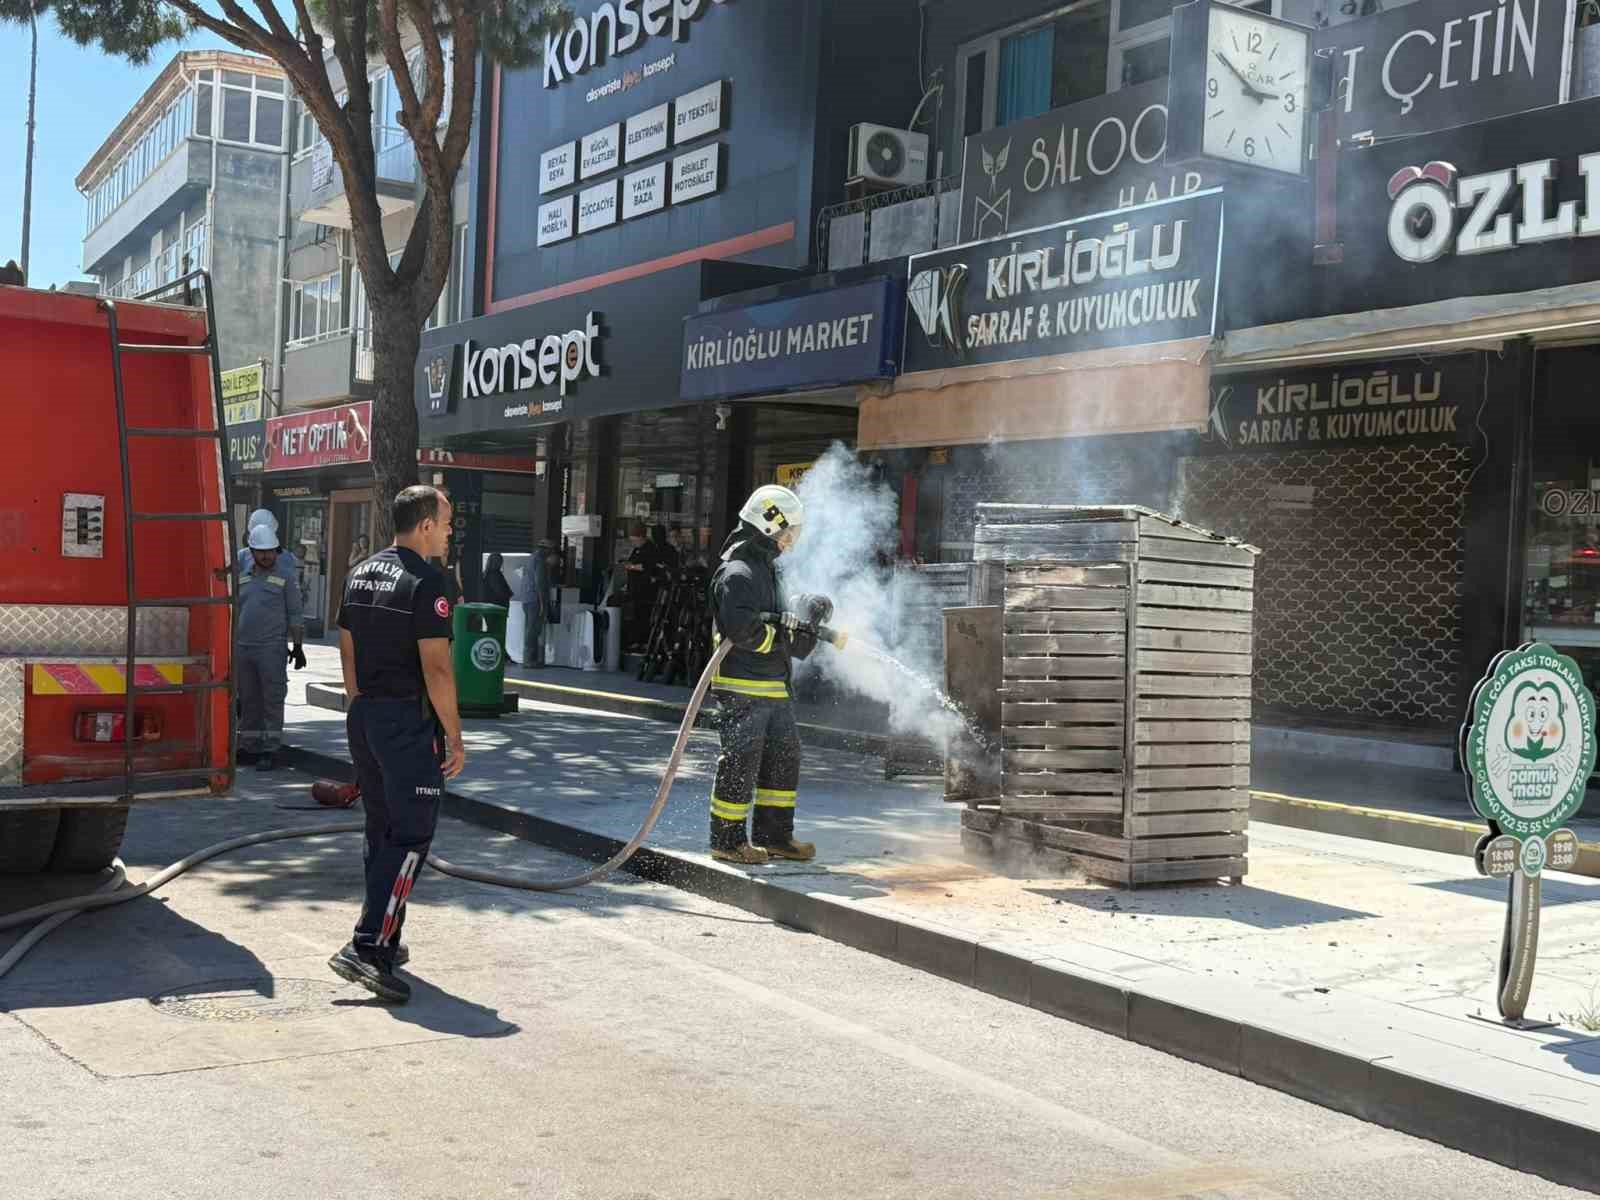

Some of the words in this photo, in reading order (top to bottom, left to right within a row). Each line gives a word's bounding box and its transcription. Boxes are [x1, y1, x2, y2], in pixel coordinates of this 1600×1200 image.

[1247, 32, 1263, 54] 12
[1207, 78, 1218, 98] 9
[1284, 93, 1296, 113] 3
[677, 112, 687, 126] EV
[1243, 137, 1255, 158] 6
[547, 153, 567, 169] BEYAZ
[632, 176, 656, 192] YATAK
[633, 192, 653, 206] BAZA
[986, 220, 1190, 301] KİRLİOĞLU
[966, 307, 1034, 349] SARRAF
[1037, 309, 1051, 339] &
[1056, 279, 1201, 337] KUYUMCULUK
[462, 311, 600, 398] konsept
[686, 325, 782, 371] KİRLİOĞLU
[786, 312, 874, 356] MARKET
[1256, 370, 1442, 416] KİRLİOĞLU
[1239, 416, 1305, 445] SARRAF
[1308, 416, 1321, 441] &
[1327, 405, 1458, 440] KUYUMCULUK
[281, 424, 307, 456] NET
[353, 561, 404, 581] ANTALYA
[1489, 674, 1507, 700] ÇÖP
[1507, 653, 1538, 676] TAKSİ
[1539, 655, 1580, 693] TOPLAMA
[1577, 694, 1591, 754] NOKTASI
[1509, 765, 1558, 791] pamuk
[1480, 781, 1500, 813] 0540
[1516, 820, 1528, 834] 55
[1529, 819, 1542, 833] 55
[1549, 802, 1569, 825] 444
